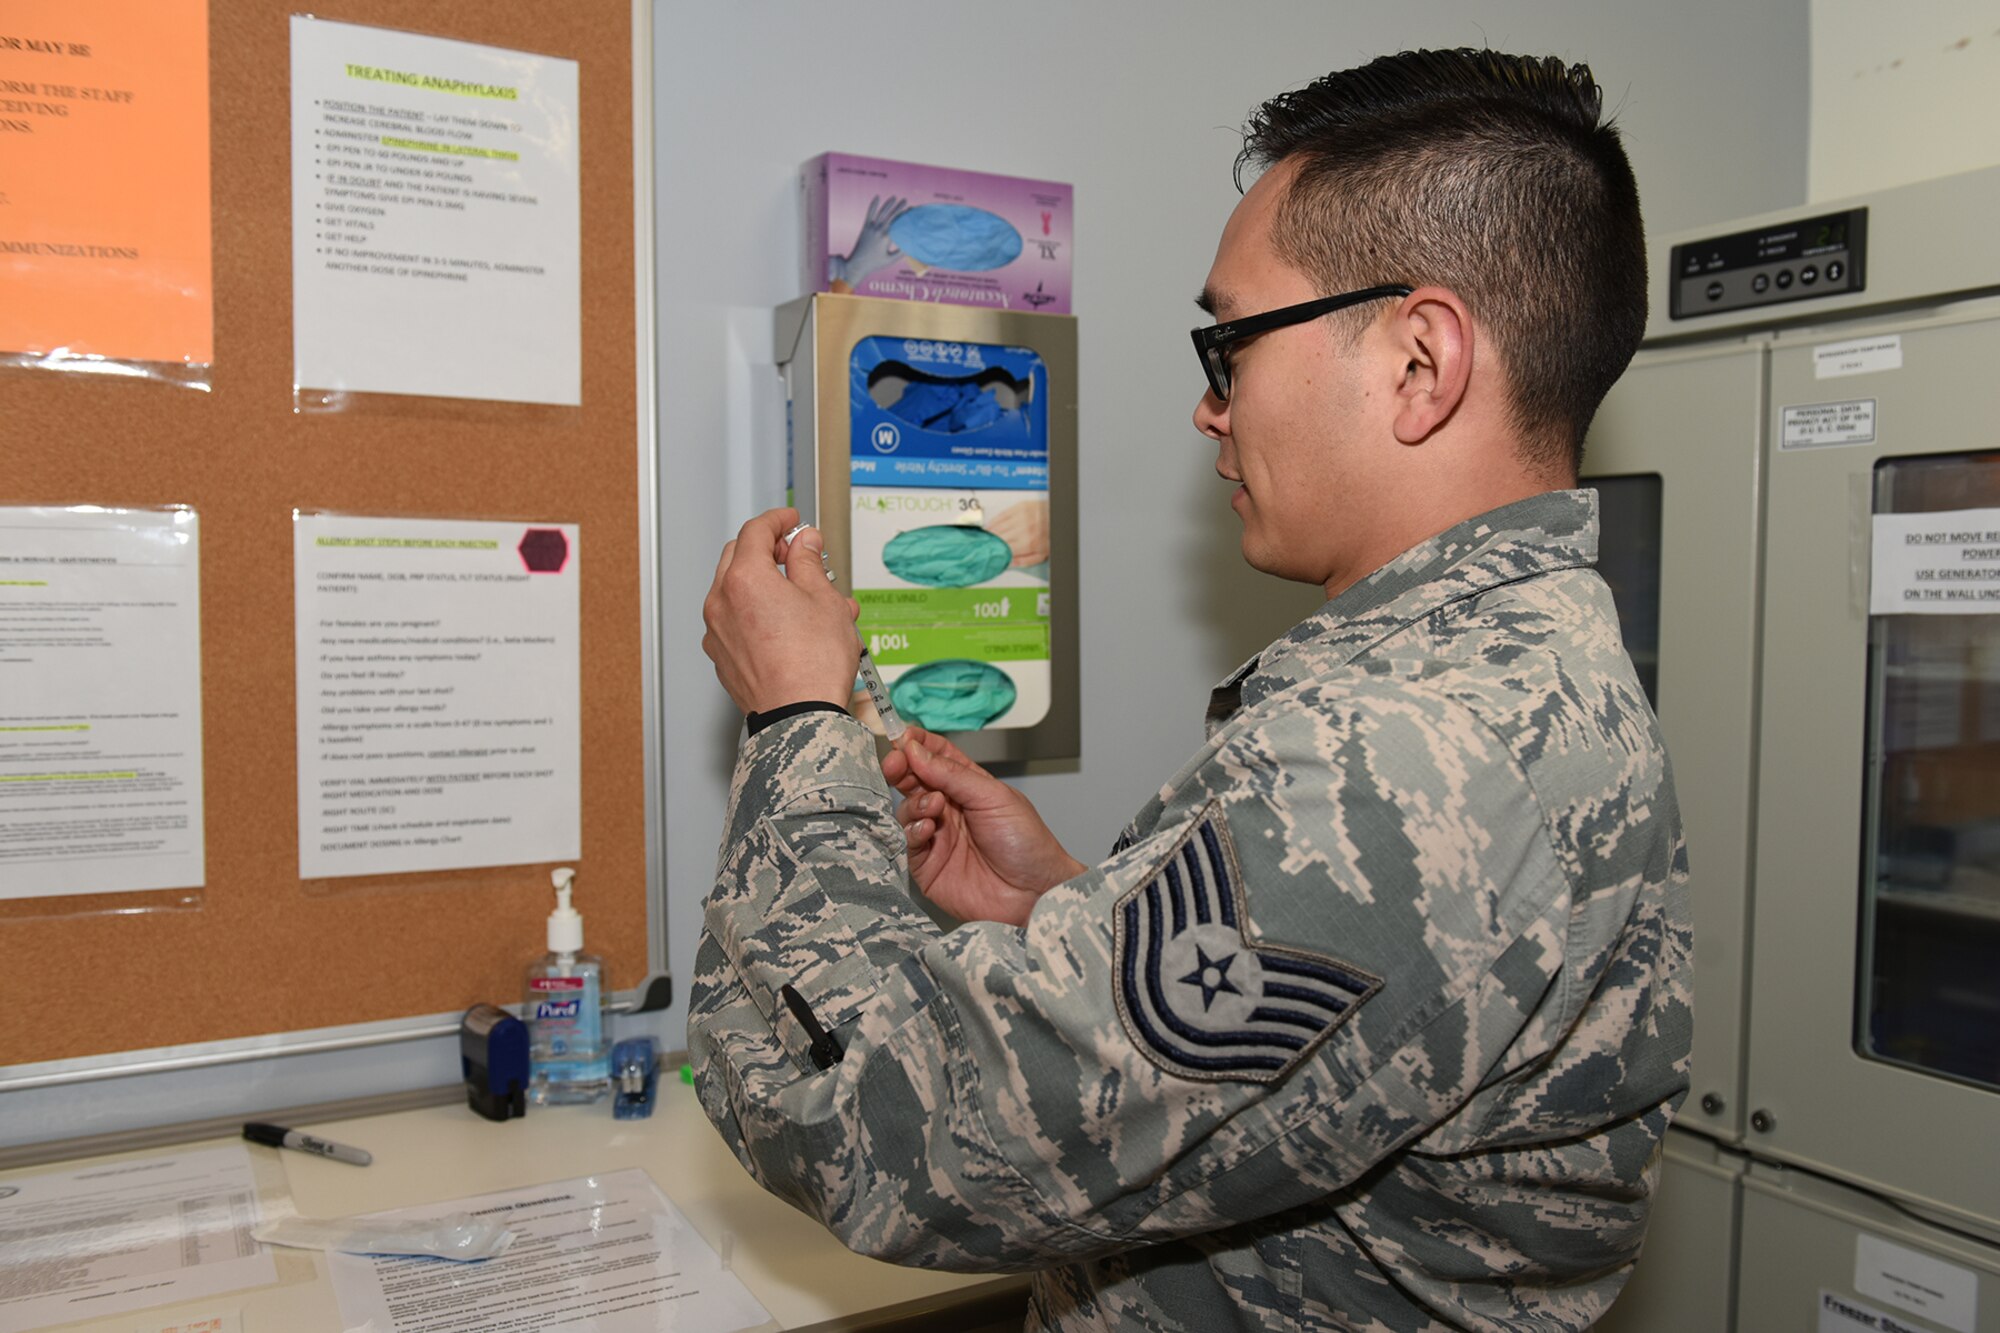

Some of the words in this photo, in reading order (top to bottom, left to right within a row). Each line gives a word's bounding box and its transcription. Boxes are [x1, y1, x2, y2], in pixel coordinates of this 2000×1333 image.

[24, 38, 64, 54] MAY
[68, 42, 91, 57] BE
[345, 64, 418, 87] TREATING
[421, 75, 517, 99] ANAPHYLAXIS
[41, 84, 77, 98] THE
[80, 88, 134, 102] STAFF
[878, 430, 894, 446] M
[1905, 532, 1922, 544] DO
[1925, 532, 1947, 542] NOT
[1950, 532, 1981, 542] MOVE
[1916, 569, 1934, 580] USE
[1904, 589, 1920, 600] ON
[1924, 589, 1942, 600] THE
[1947, 588, 1975, 600] WALL
[973, 603, 1000, 618] 100
[882, 634, 910, 650] 100
[540, 1002, 578, 1018] Purell
[1824, 1294, 1878, 1326] Freezer
